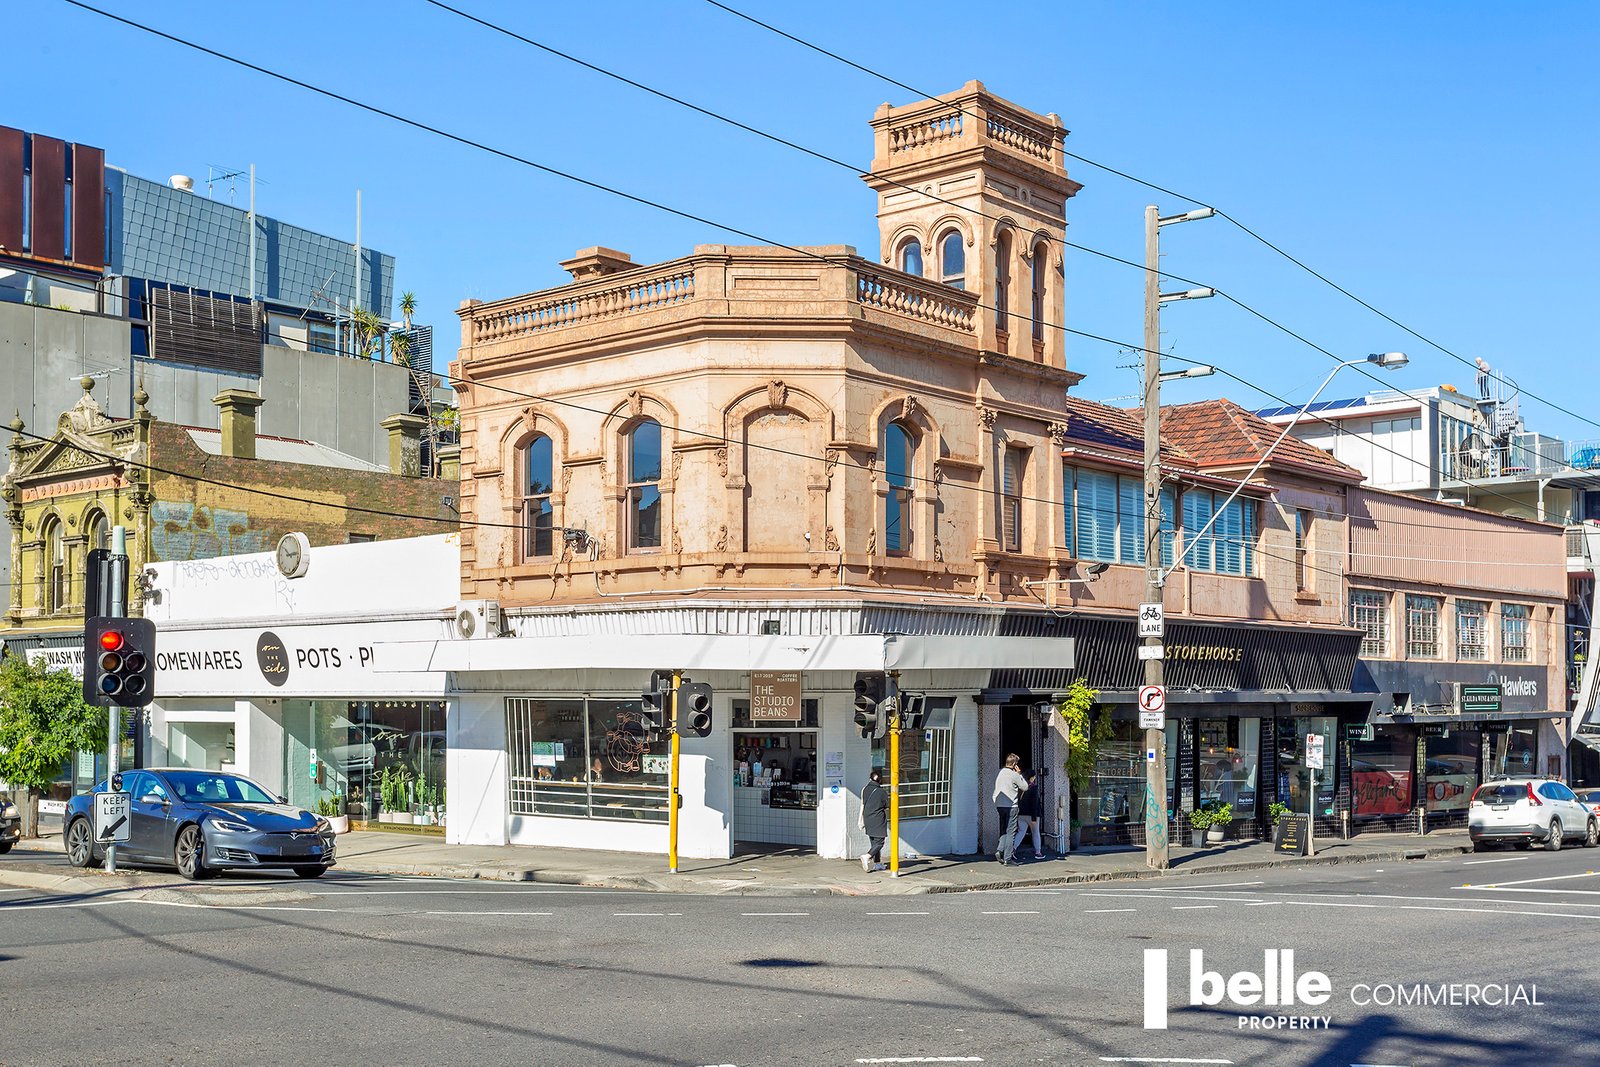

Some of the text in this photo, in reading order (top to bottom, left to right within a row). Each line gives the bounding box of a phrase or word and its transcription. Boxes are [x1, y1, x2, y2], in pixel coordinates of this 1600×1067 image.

[1141, 624, 1161, 632] LANE
[47, 651, 73, 664] WASH
[1165, 644, 1243, 661] STOREHOUSE
[155, 650, 243, 671] OMEWARES
[296, 647, 342, 669] POTS
[263, 664, 287, 674] side
[754, 685, 775, 695] THE
[1500, 675, 1537, 696] Hawkers
[754, 695, 794, 706] STUDIO
[754, 706, 788, 717] BEANS
[1349, 728, 1367, 736] WINE
[380, 751, 402, 759] THE
[103, 796, 126, 805] KEEP
[104, 806, 125, 815] LEFT
